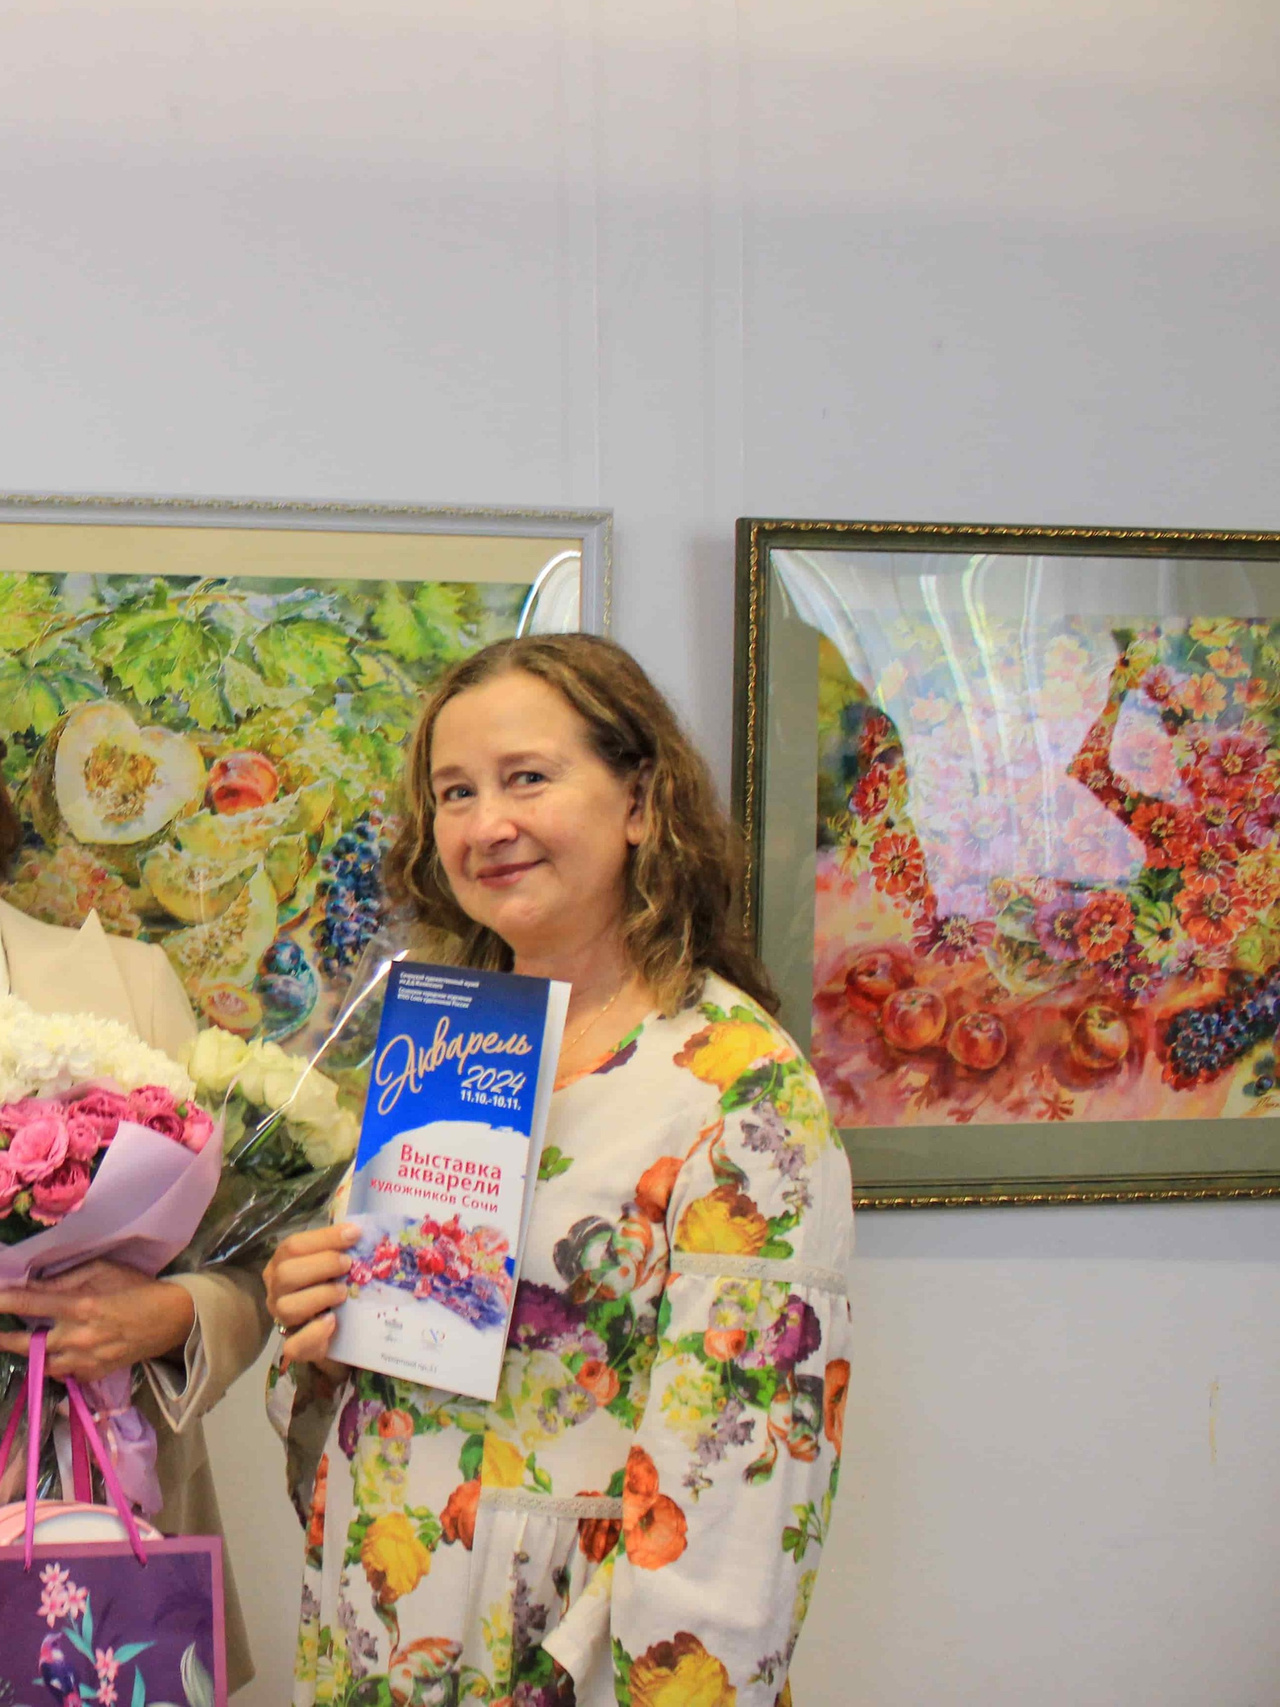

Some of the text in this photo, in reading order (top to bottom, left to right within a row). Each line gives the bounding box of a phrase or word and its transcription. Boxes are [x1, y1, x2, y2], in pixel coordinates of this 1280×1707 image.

[375, 1015, 533, 1116] Акварель
[460, 1065, 527, 1096] 2024
[400, 1143, 503, 1180] Выставка
[370, 1177, 499, 1213] художников Сочи
[398, 1163, 501, 1197] акварели
